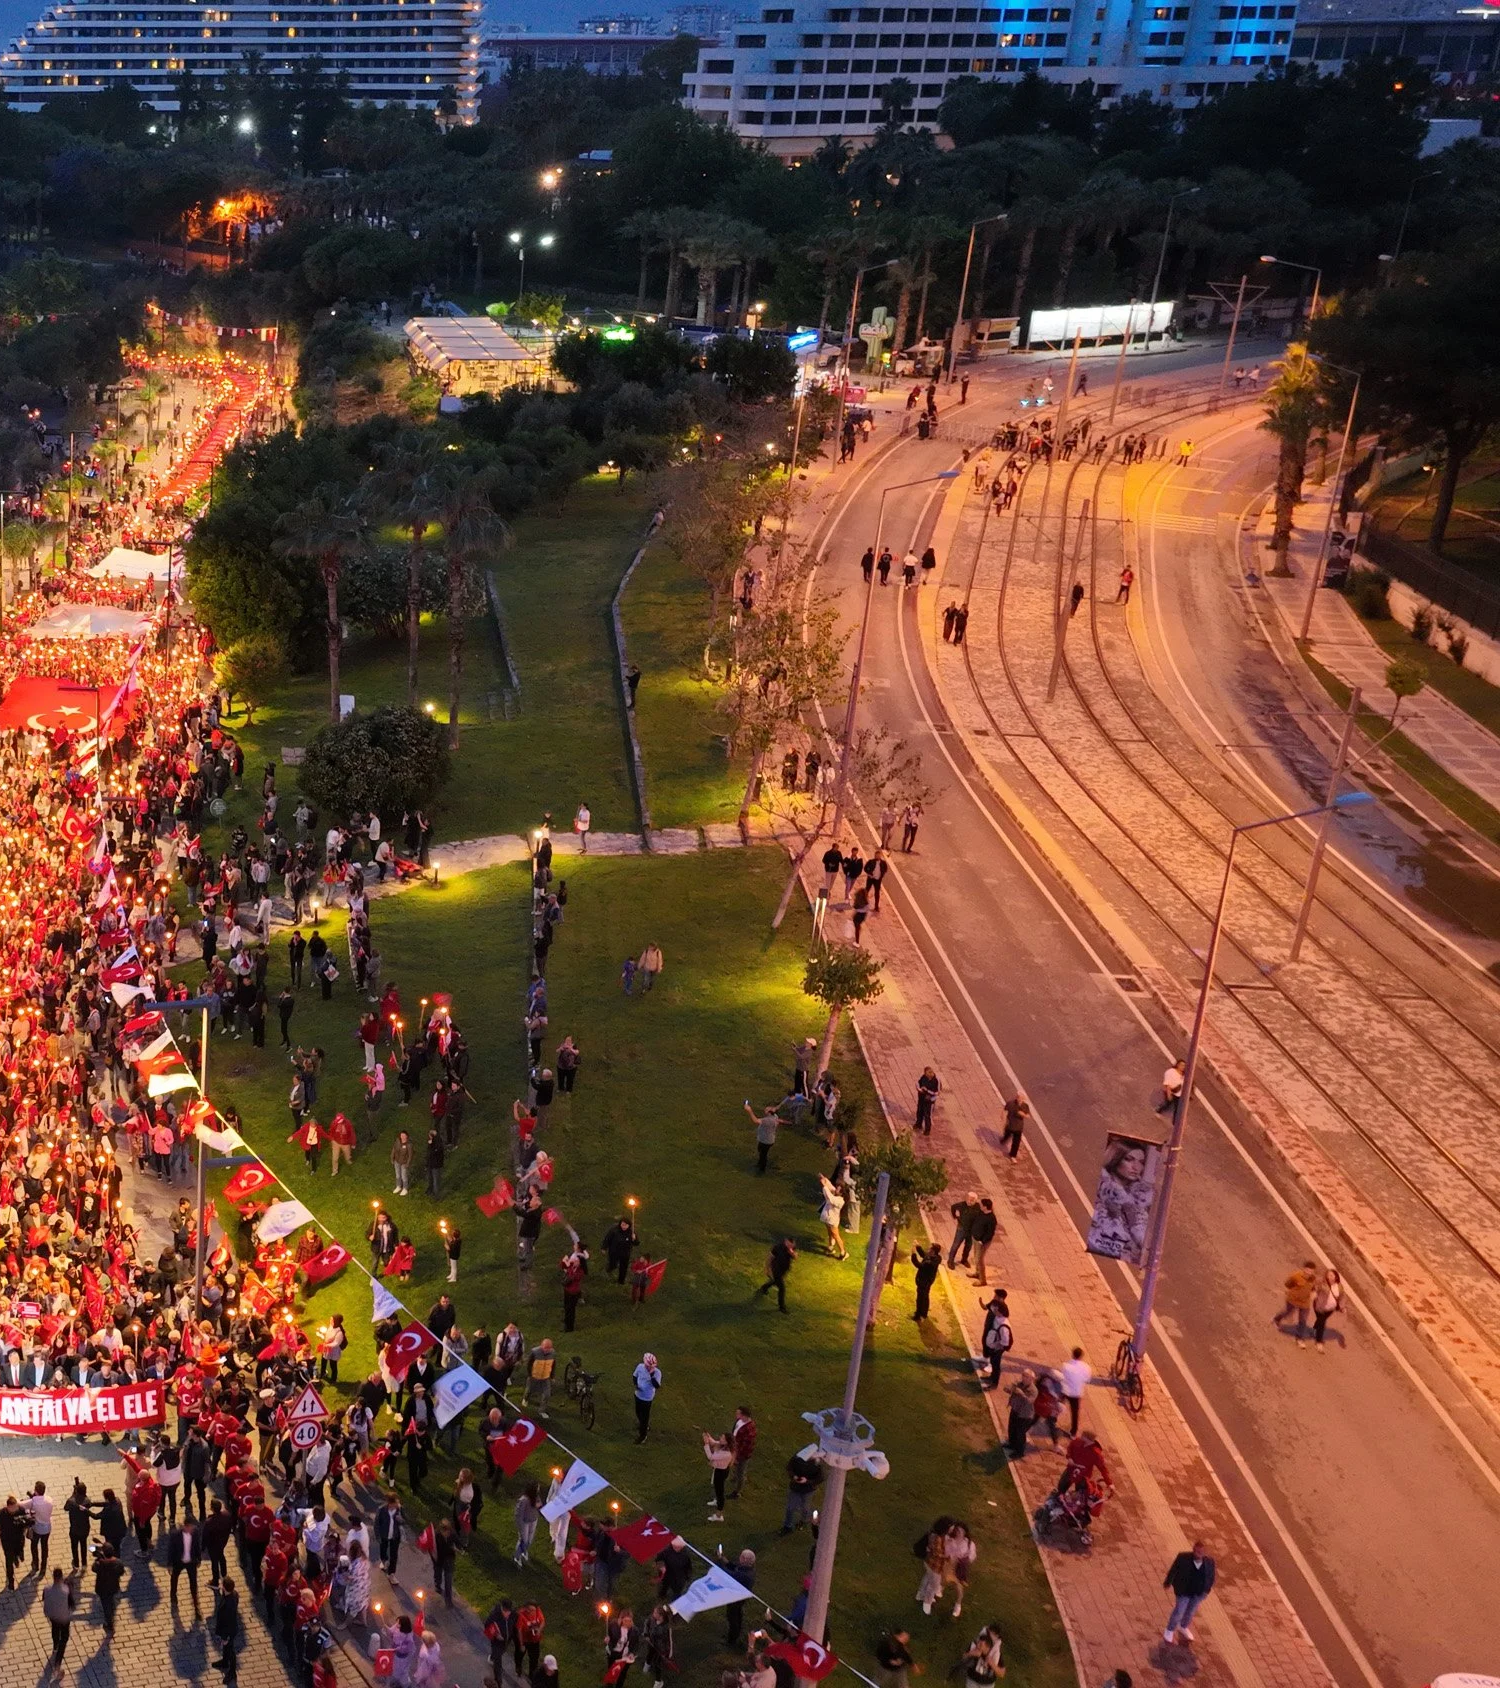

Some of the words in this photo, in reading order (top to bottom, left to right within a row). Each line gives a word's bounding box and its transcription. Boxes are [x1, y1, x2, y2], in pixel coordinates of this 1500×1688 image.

[0, 1396, 94, 1427] ANTALYA
[96, 1396, 120, 1422] EL
[122, 1389, 159, 1420] ELE
[296, 1426, 316, 1441] 40
